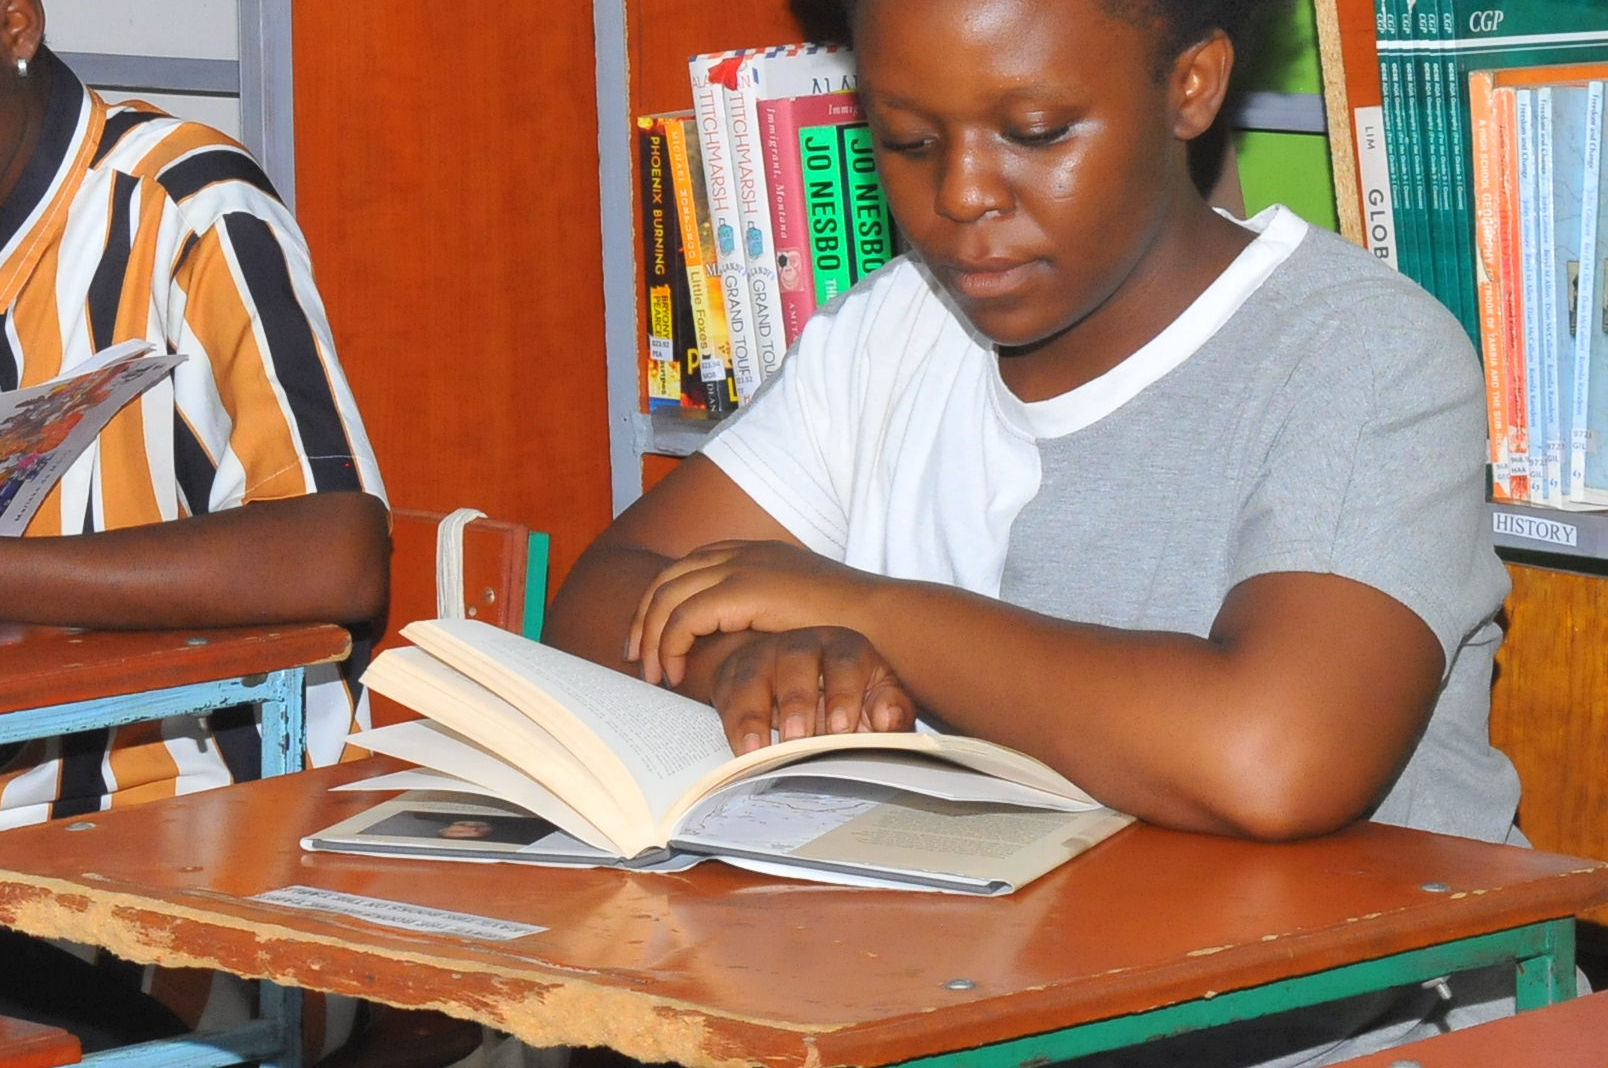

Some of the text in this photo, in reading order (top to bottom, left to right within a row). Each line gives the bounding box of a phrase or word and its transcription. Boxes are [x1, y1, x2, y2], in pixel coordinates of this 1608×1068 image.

[1419, 13, 1427, 33] CGP
[1444, 13, 1452, 34] CGP
[1469, 10, 1504, 32] CGP
[699, 90, 729, 212] TITCHMARSH
[729, 93, 758, 214] TITCHMARSH
[1365, 126, 1376, 150] LIM
[671, 131, 696, 259] MICHAEL MORPURGO
[1480, 152, 1490, 190] SCHOOL
[650, 136, 665, 275] PHOENIX BURNING
[775, 184, 787, 239] Montana
[805, 137, 841, 271] JO NESBO
[851, 138, 886, 273] JO NESBO
[1482, 193, 1493, 267] GEOGRAPHY
[654, 295, 662, 338] PEARCE
[661, 295, 670, 340] BRYONY
[691, 271, 707, 350] Little Foxes
[725, 275, 743, 332] GRAND
[753, 279, 771, 337] GRAND
[652, 350, 662, 358] PEA
[1496, 515, 1574, 543] HISTORY
